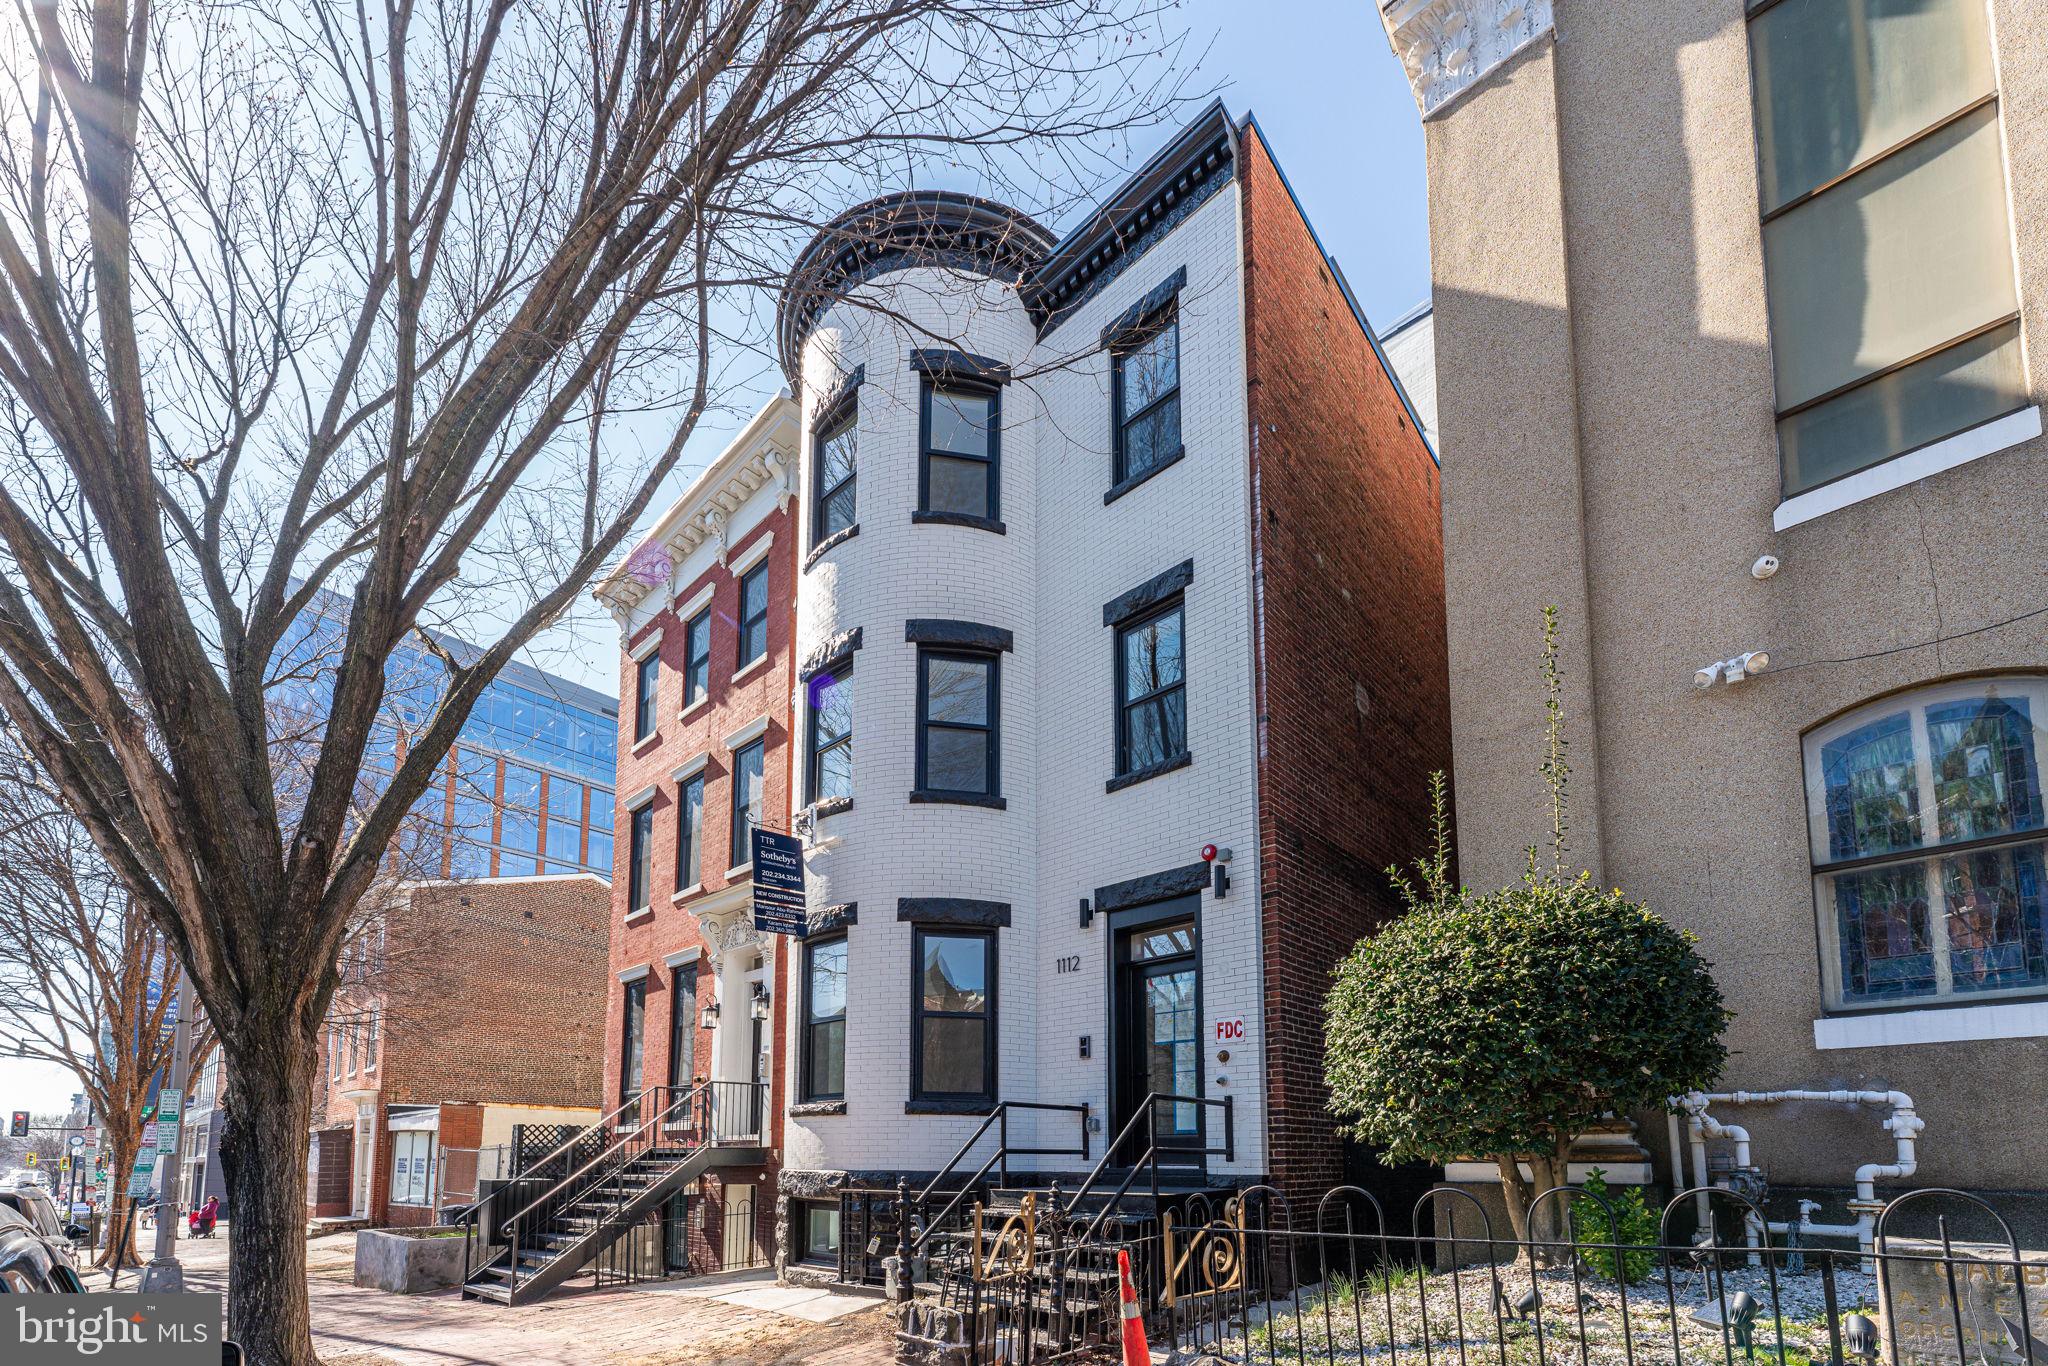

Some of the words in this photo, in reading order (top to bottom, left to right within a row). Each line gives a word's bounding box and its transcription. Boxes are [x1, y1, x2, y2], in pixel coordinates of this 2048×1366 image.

[760, 835, 775, 846] TTR
[760, 850, 797, 865] Sotheby's
[761, 869, 802, 883] 202.234.3344
[768, 892, 804, 903] CONSTRUCTION
[1056, 955, 1082, 974] 1112
[1216, 1019, 1244, 1040] FDC
